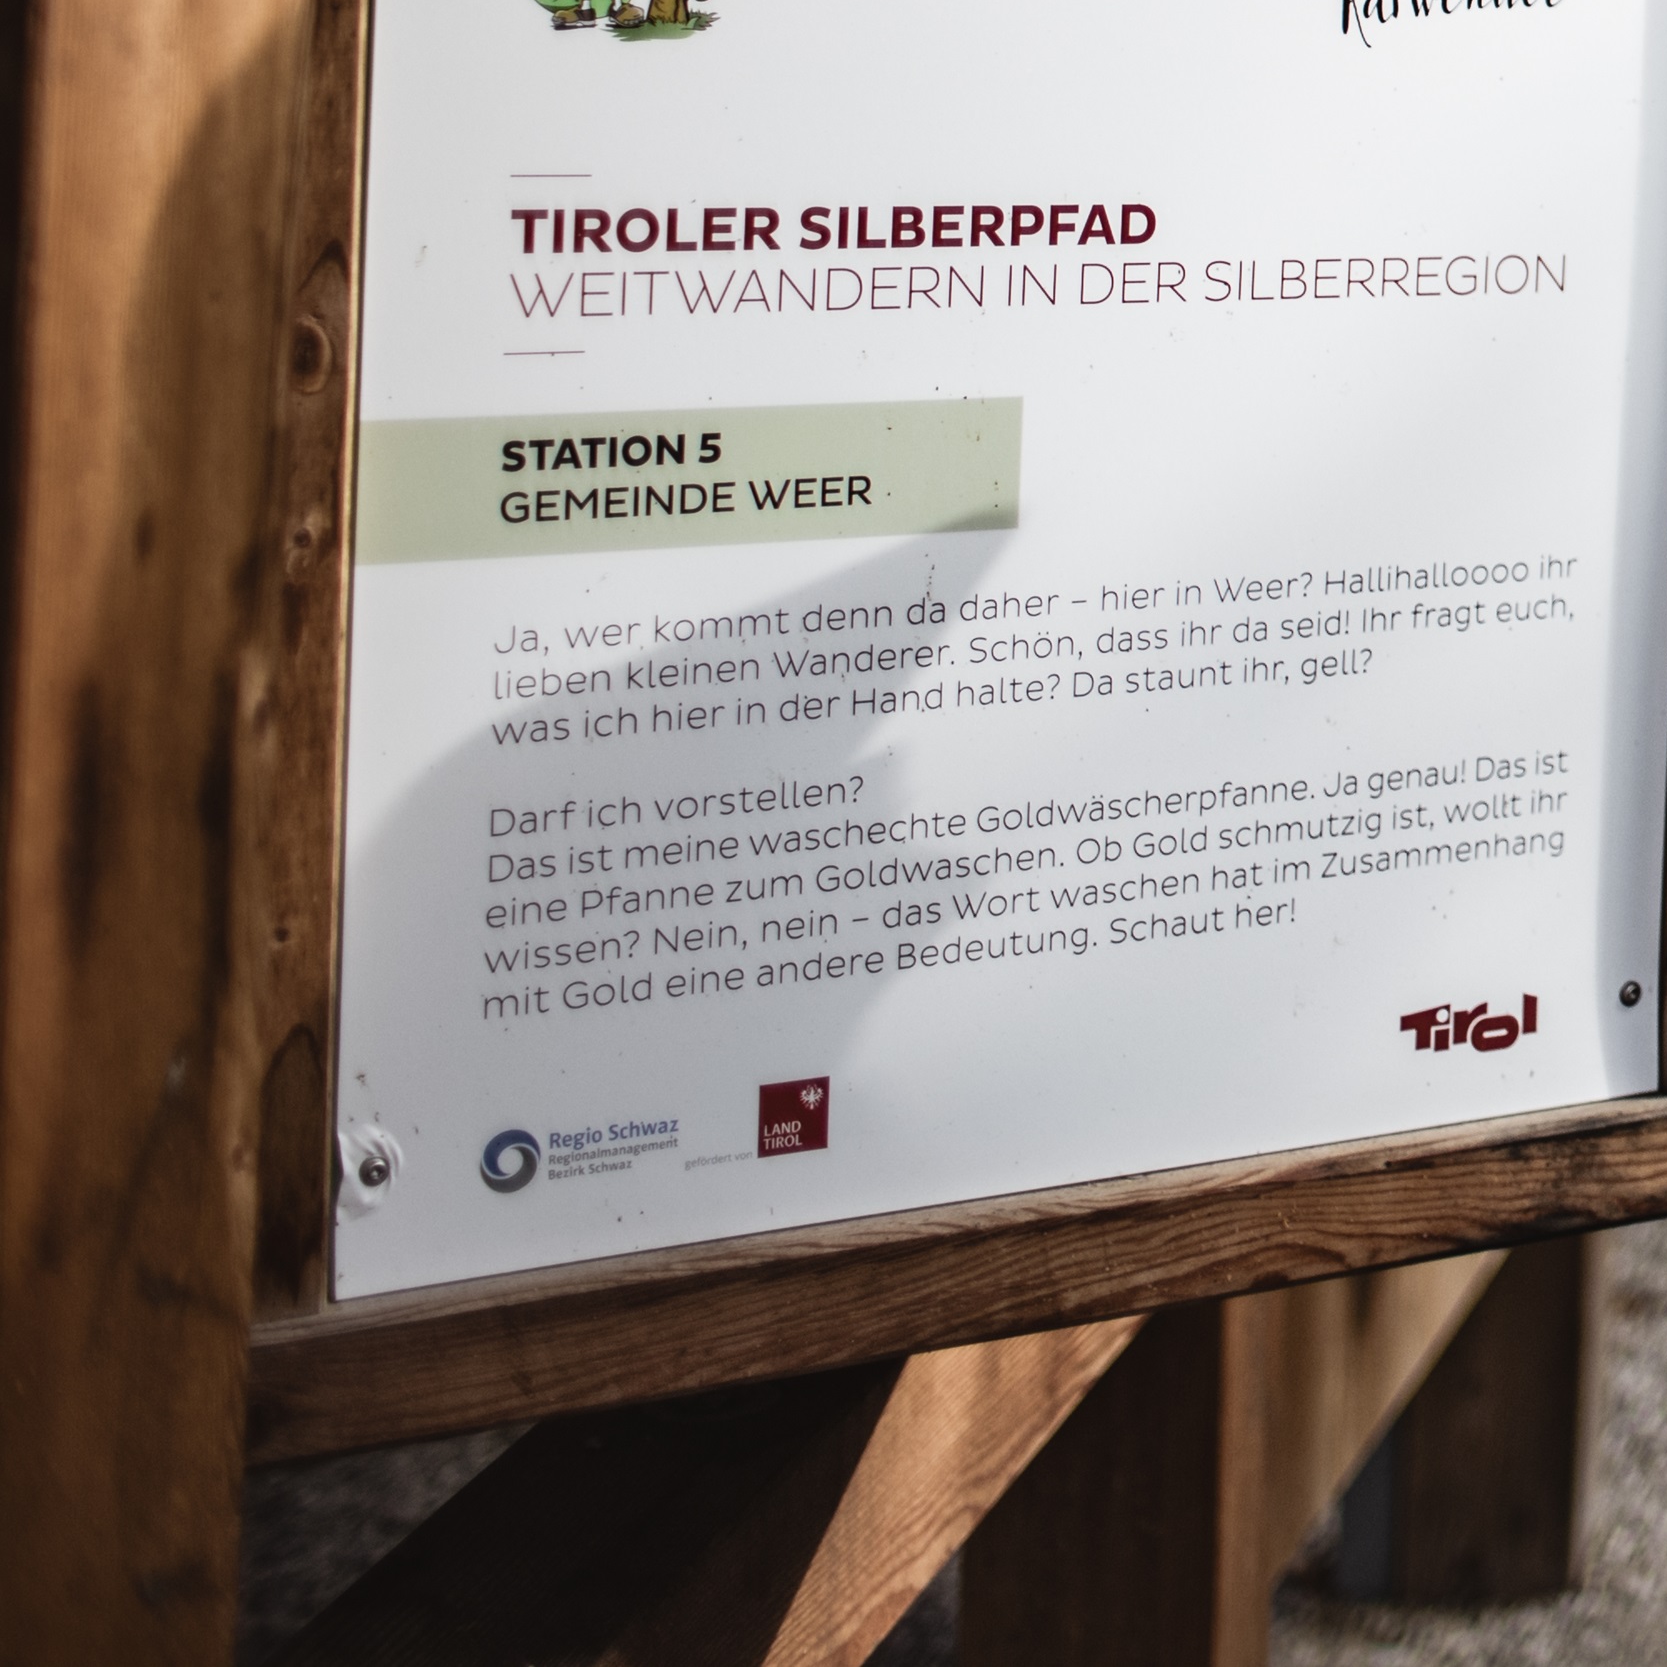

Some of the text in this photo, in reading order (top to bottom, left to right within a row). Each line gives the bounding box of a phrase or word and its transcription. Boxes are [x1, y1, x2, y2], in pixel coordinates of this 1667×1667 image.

[510, 203, 1157, 255] TIROLER SILBERPFAD
[509, 253, 1567, 319] WEITWANDERN IN DER SILBERREGION
[501, 432, 722, 473] STATION 5
[499, 475, 873, 524] GEMEINDE WEER
[493, 624, 549, 657] Ja,
[563, 622, 642, 650] wer
[654, 607, 790, 644] kommt
[801, 603, 893, 633] denn
[905, 595, 946, 626] da
[959, 591, 1060, 622] daher
[1101, 583, 1166, 612] hier
[1175, 579, 1202, 607] in
[1213, 571, 1314, 604] Weer?
[1324, 561, 1530, 596] Hallihalloooo
[1539, 554, 1578, 580] ihr
[494, 593, 1575, 701] lieben kleinen Wanderer. Schön, dass ihr da seid! Ihr fragt euch,
[491, 647, 1373, 746] was ich hier in der Hand halte? Da staunt ihr, gell?
[487, 750, 1569, 884] Das ist meine waschechte Goldwäscherpfanne. Ja genau! Das ist
[489, 775, 864, 838] Darf ich vorstellen?
[484, 789, 1568, 930] eine Pfanne zum Goldwaschen. Ob Gold schmutzig ist, wollt ihr
[483, 929, 641, 974] wissen?
[653, 920, 748, 956] Nein,
[761, 909, 838, 944] nein
[881, 899, 942, 930] das
[951, 886, 1041, 921] Wort
[1049, 872, 1200, 910] waschen
[1211, 861, 1264, 894] hat
[1273, 857, 1311, 884] im
[1320, 830, 1565, 879] Zusammenhang
[482, 897, 1296, 1021] mit Gold eine andere Bedeutung. Schaut her!
[1400, 992, 1537, 1053] Tirol
[548, 1137, 679, 1166] Regionalmanagement
[549, 1119, 679, 1150] Regio Schwaz
[763, 1120, 802, 1137] LAND
[763, 1135, 803, 1150] TIROL
[548, 1160, 632, 1180] Bezirk Schwaz
[684, 1151, 753, 1171] gefördert von
